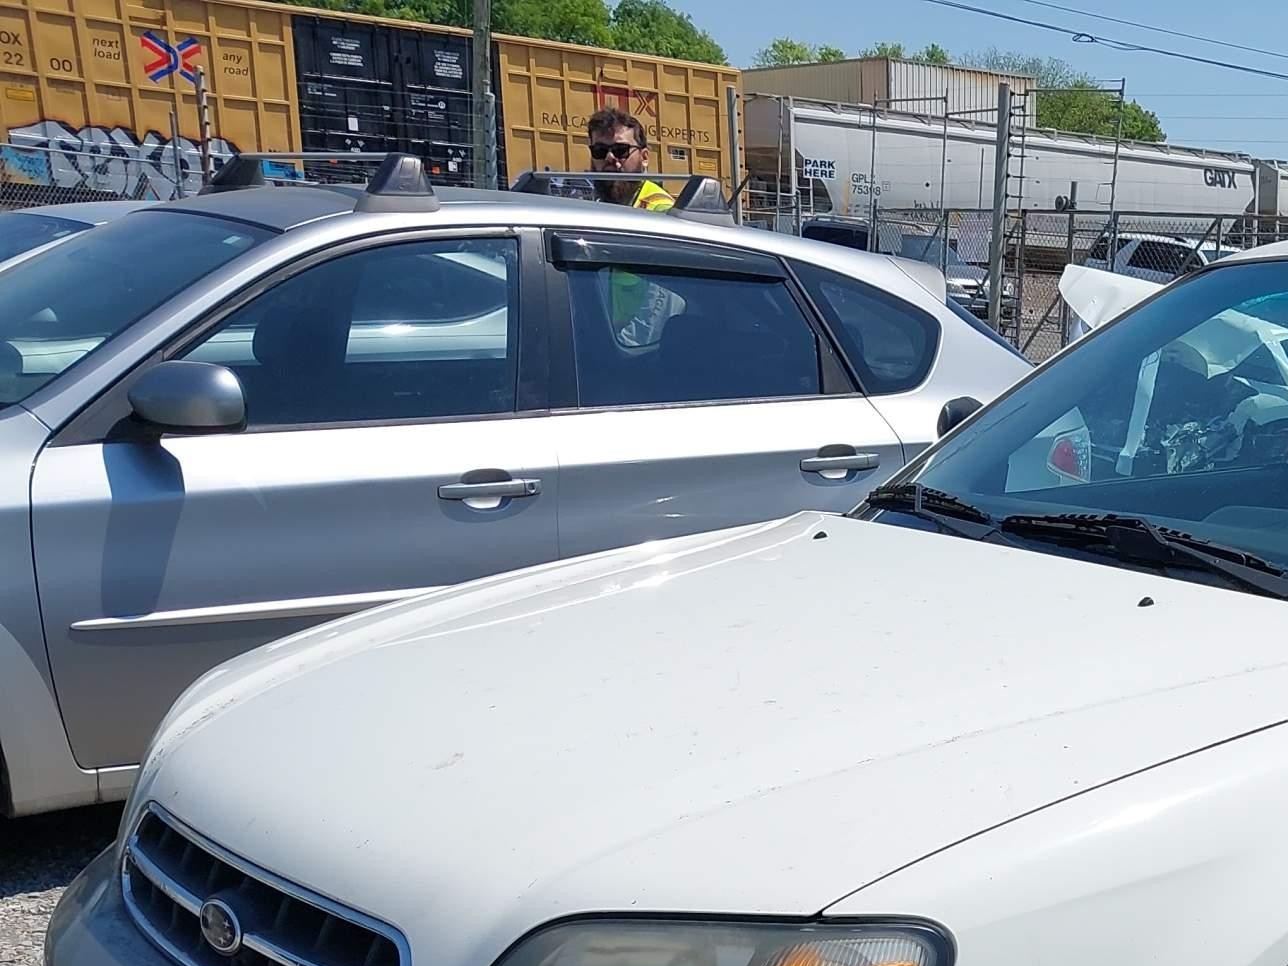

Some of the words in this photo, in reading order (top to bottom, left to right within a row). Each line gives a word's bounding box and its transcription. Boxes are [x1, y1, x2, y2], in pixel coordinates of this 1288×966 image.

[92, 38, 119, 49] next
[94, 48, 121, 61] load
[222, 52, 243, 65] any
[49, 57, 73, 73] 00
[223, 66, 249, 77] road
[542, 112, 588, 129] RAILCA
[661, 126, 710, 143] EXPERTS
[804, 159, 836, 170] PARK
[804, 168, 835, 179] HERE
[1203, 168, 1238, 190] GATX
